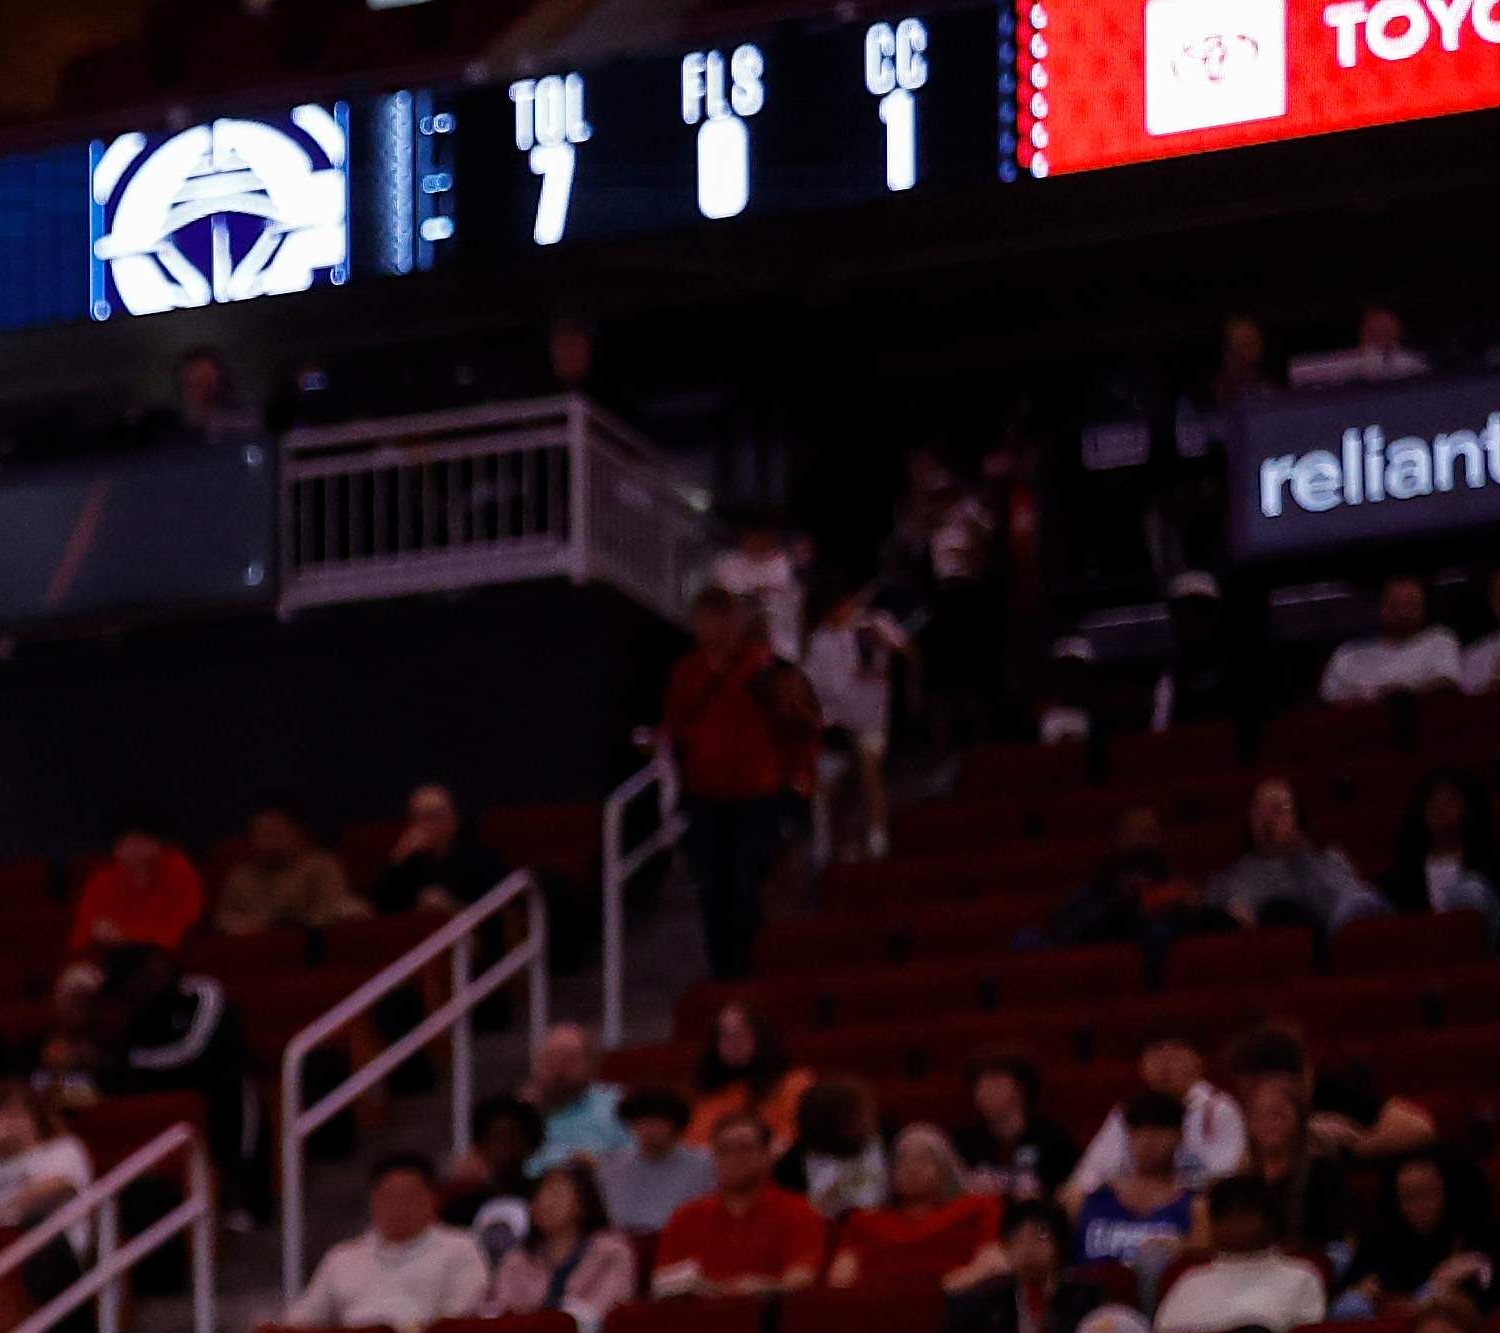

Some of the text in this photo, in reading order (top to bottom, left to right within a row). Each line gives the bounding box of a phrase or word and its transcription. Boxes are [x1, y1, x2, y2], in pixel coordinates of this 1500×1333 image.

[682, 43, 765, 125] FLS
[866, 16, 928, 95] CC
[530, 88, 917, 245] 7 0 1
[1260, 411, 1500, 518] reliant
